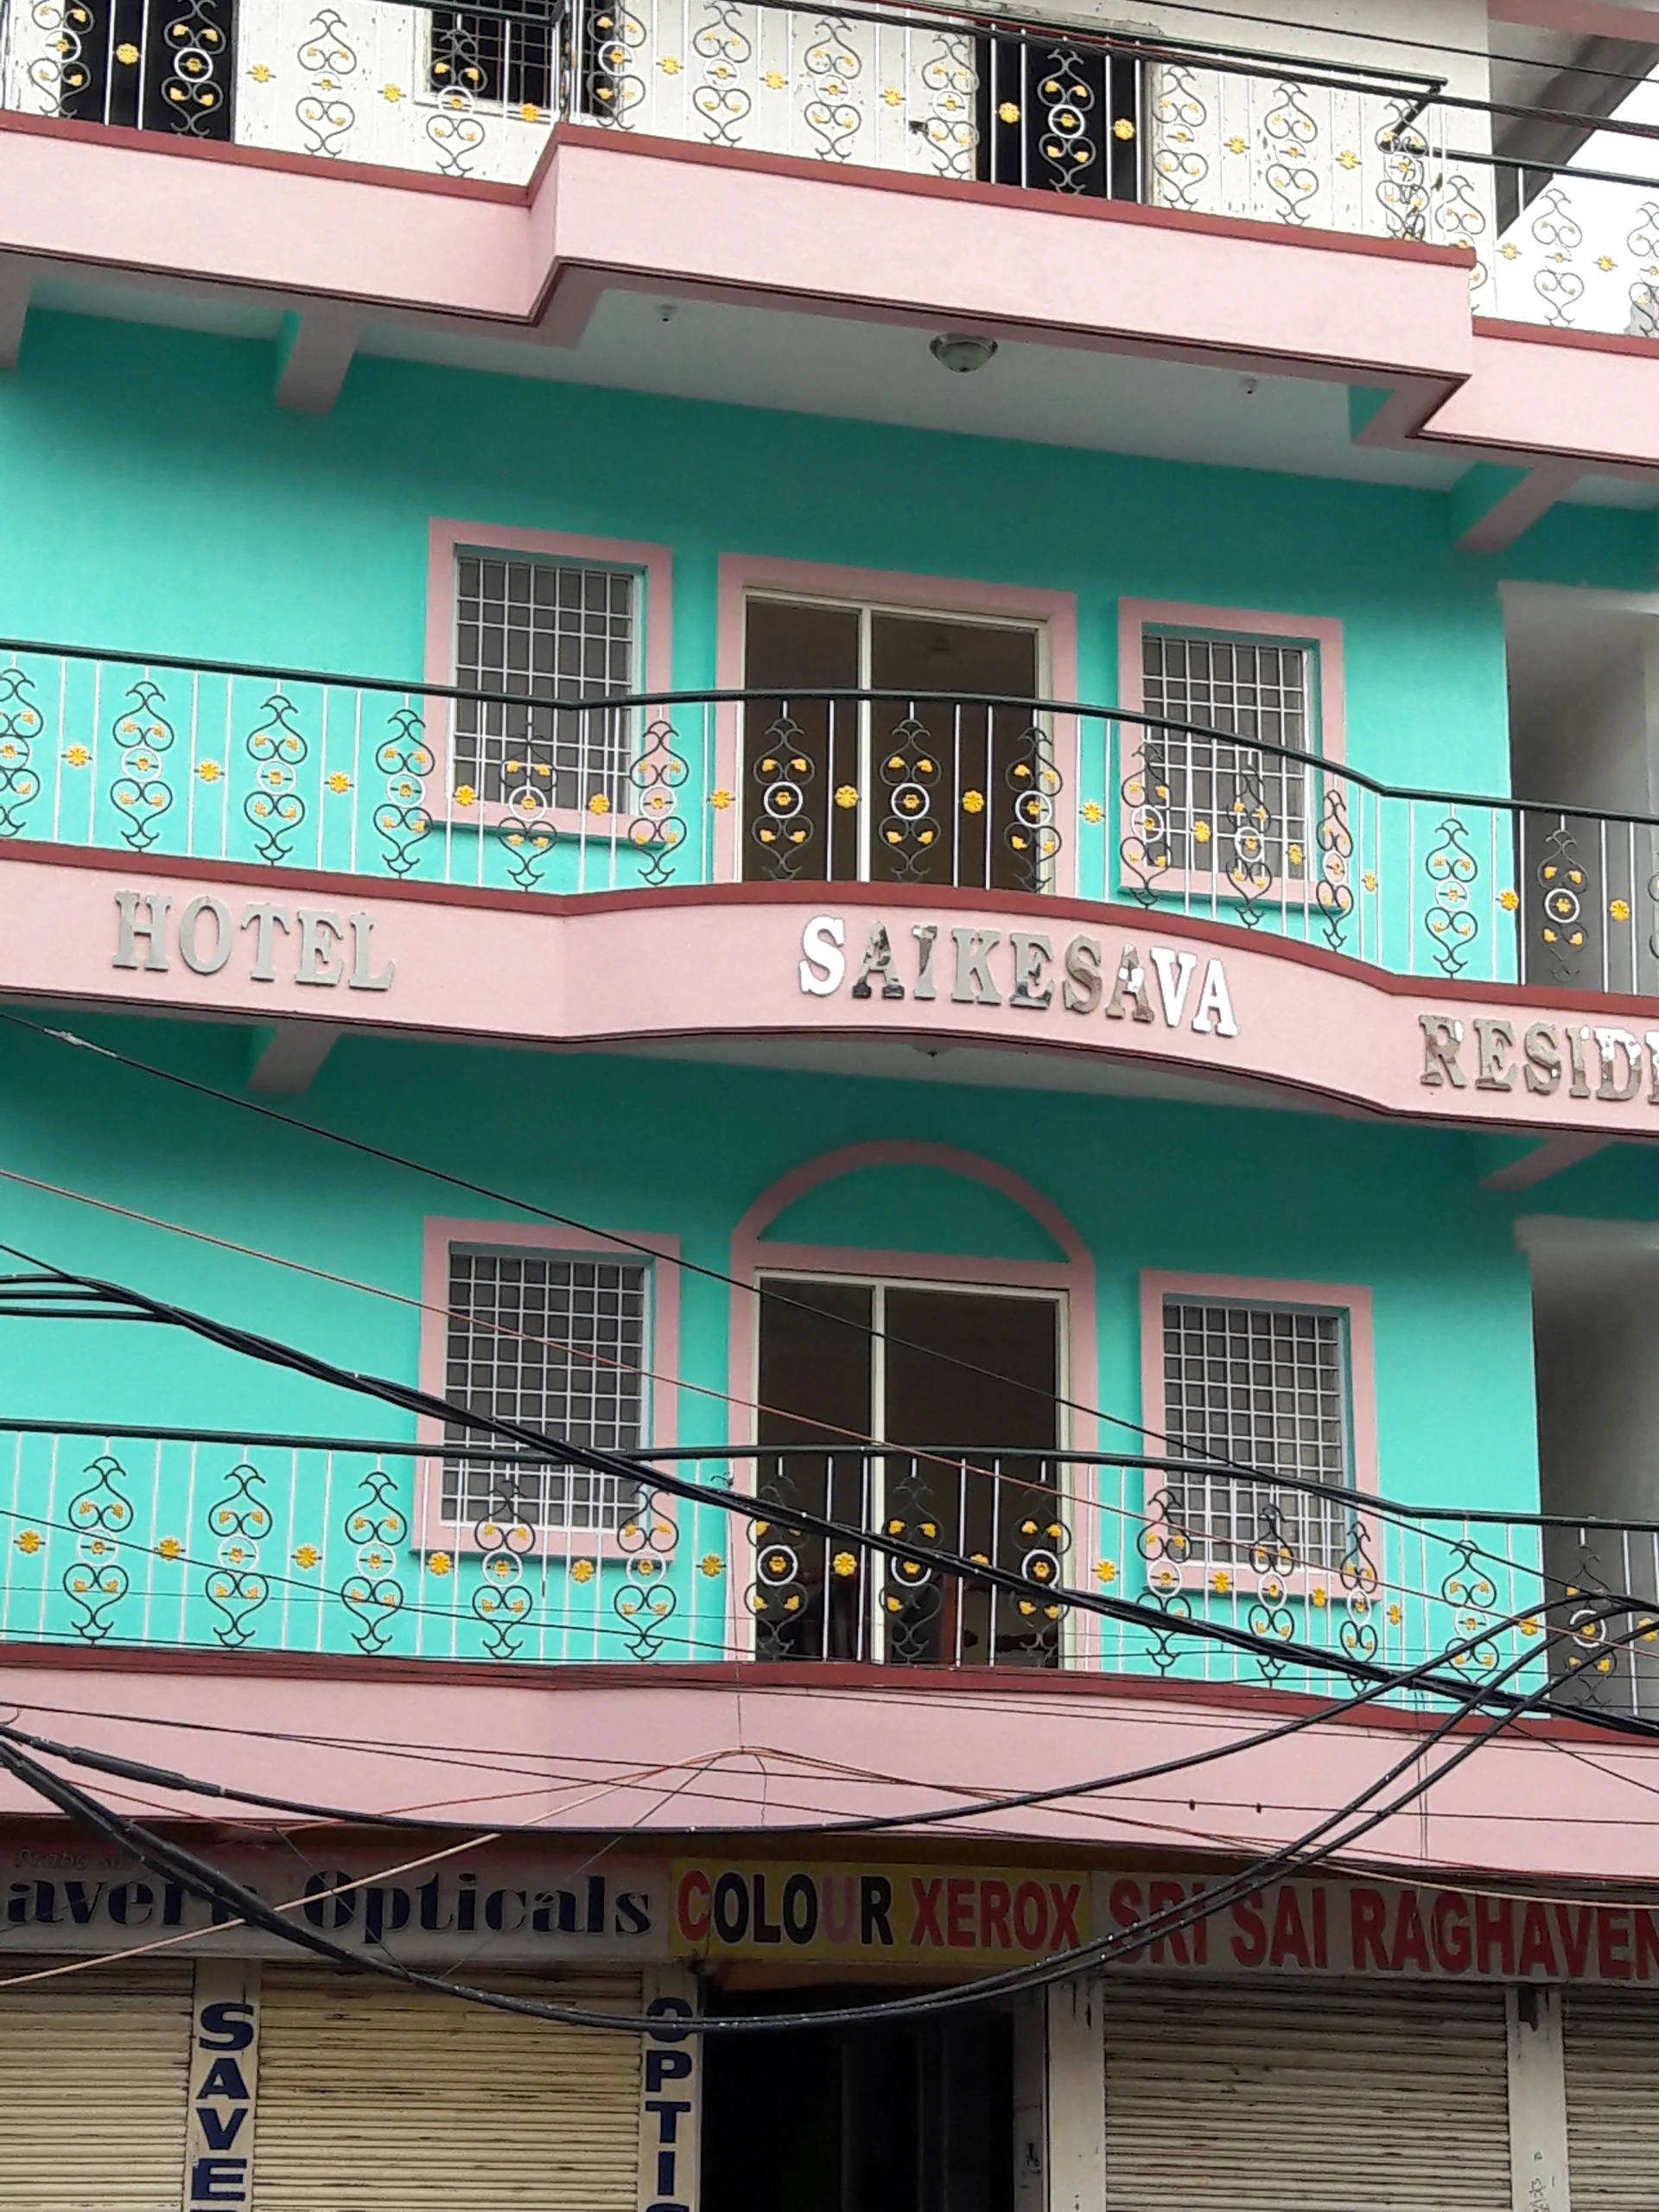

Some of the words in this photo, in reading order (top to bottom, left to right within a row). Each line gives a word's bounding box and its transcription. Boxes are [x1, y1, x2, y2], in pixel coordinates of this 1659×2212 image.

[112, 889, 397, 991] HOTEL
[798, 916, 1240, 1038] SAIKESAVA
[304, 1869, 652, 1944] Opticals
[677, 1870, 893, 1945] COLOUR
[910, 1878, 1081, 1950] XEROX
[1109, 1878, 1209, 1966] SRI
[1230, 1882, 1328, 1968] SAI
[189, 2002, 255, 2212] SAVE
[645, 1998, 693, 2212] OPTI
